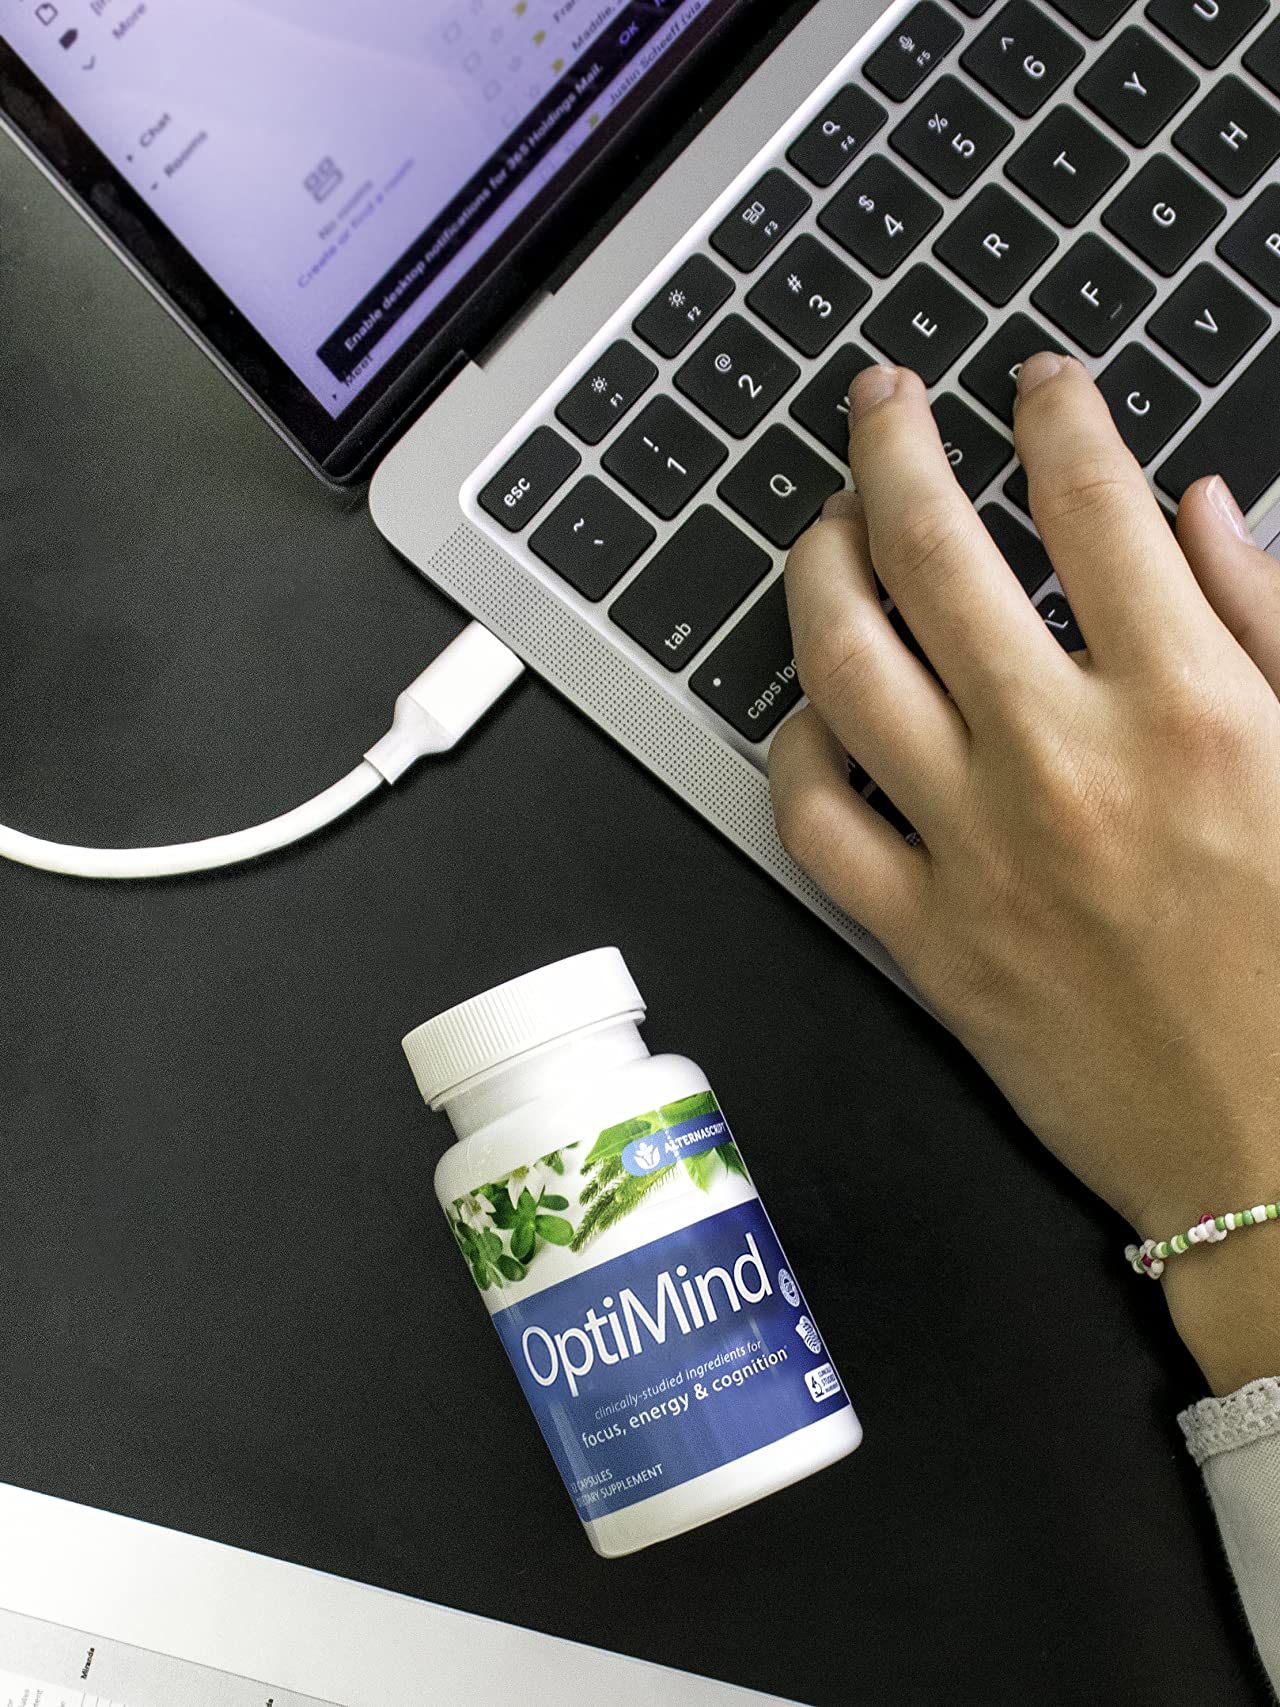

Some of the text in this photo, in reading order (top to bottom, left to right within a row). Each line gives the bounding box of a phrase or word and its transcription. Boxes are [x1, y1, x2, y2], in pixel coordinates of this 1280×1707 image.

[1193, 0, 1220, 20] U
[618, 21, 640, 46] OK
[915, 50, 932, 67] F5
[1023, 55, 1046, 78] 6
[609, 69, 641, 105] Justin
[1123, 71, 1147, 95] Y
[139, 112, 171, 147] Chat
[927, 112, 949, 134] %
[1220, 120, 1248, 150] H
[840, 135, 855, 151] F4
[951, 132, 976, 157] 5
[1053, 150, 1077, 174] T
[858, 194, 875, 212] $
[1152, 202, 1177, 226] G
[343, 309, 383, 351] Enable
[382, 260, 426, 310] desktop
[424, 187, 492, 263] notifications
[488, 169, 507, 190] for
[506, 142, 529, 171] 365
[528, 92, 577, 147] Holdings
[764, 220, 779, 236] F3
[884, 213, 904, 237] 4
[982, 233, 1010, 258] R
[787, 273, 803, 293] #
[1080, 280, 1100, 307] F
[687, 305, 702, 321] F2
[809, 294, 832, 318] 3
[911, 311, 938, 338] E
[1194, 308, 1219, 333] V
[714, 353, 733, 373] @
[738, 374, 763, 399] 2
[609, 392, 624, 408] F1
[1126, 391, 1151, 415] C
[667, 456, 687, 475] 1
[503, 477, 531, 507] esc
[769, 473, 797, 498] Q
[664, 622, 692, 651] tab
[747, 681, 782, 719] caps
[521, 1232, 773, 1398] OptiMind
[594, 1340, 762, 1420] clinically-studied ingredients for
[581, 1422, 627, 1449] focus,
[629, 1392, 690, 1429] energy
[693, 1383, 709, 1400] &
[577, 1468, 613, 1491] CAPSULES
[600, 1463, 664, 1499] SUPPLEMENT
